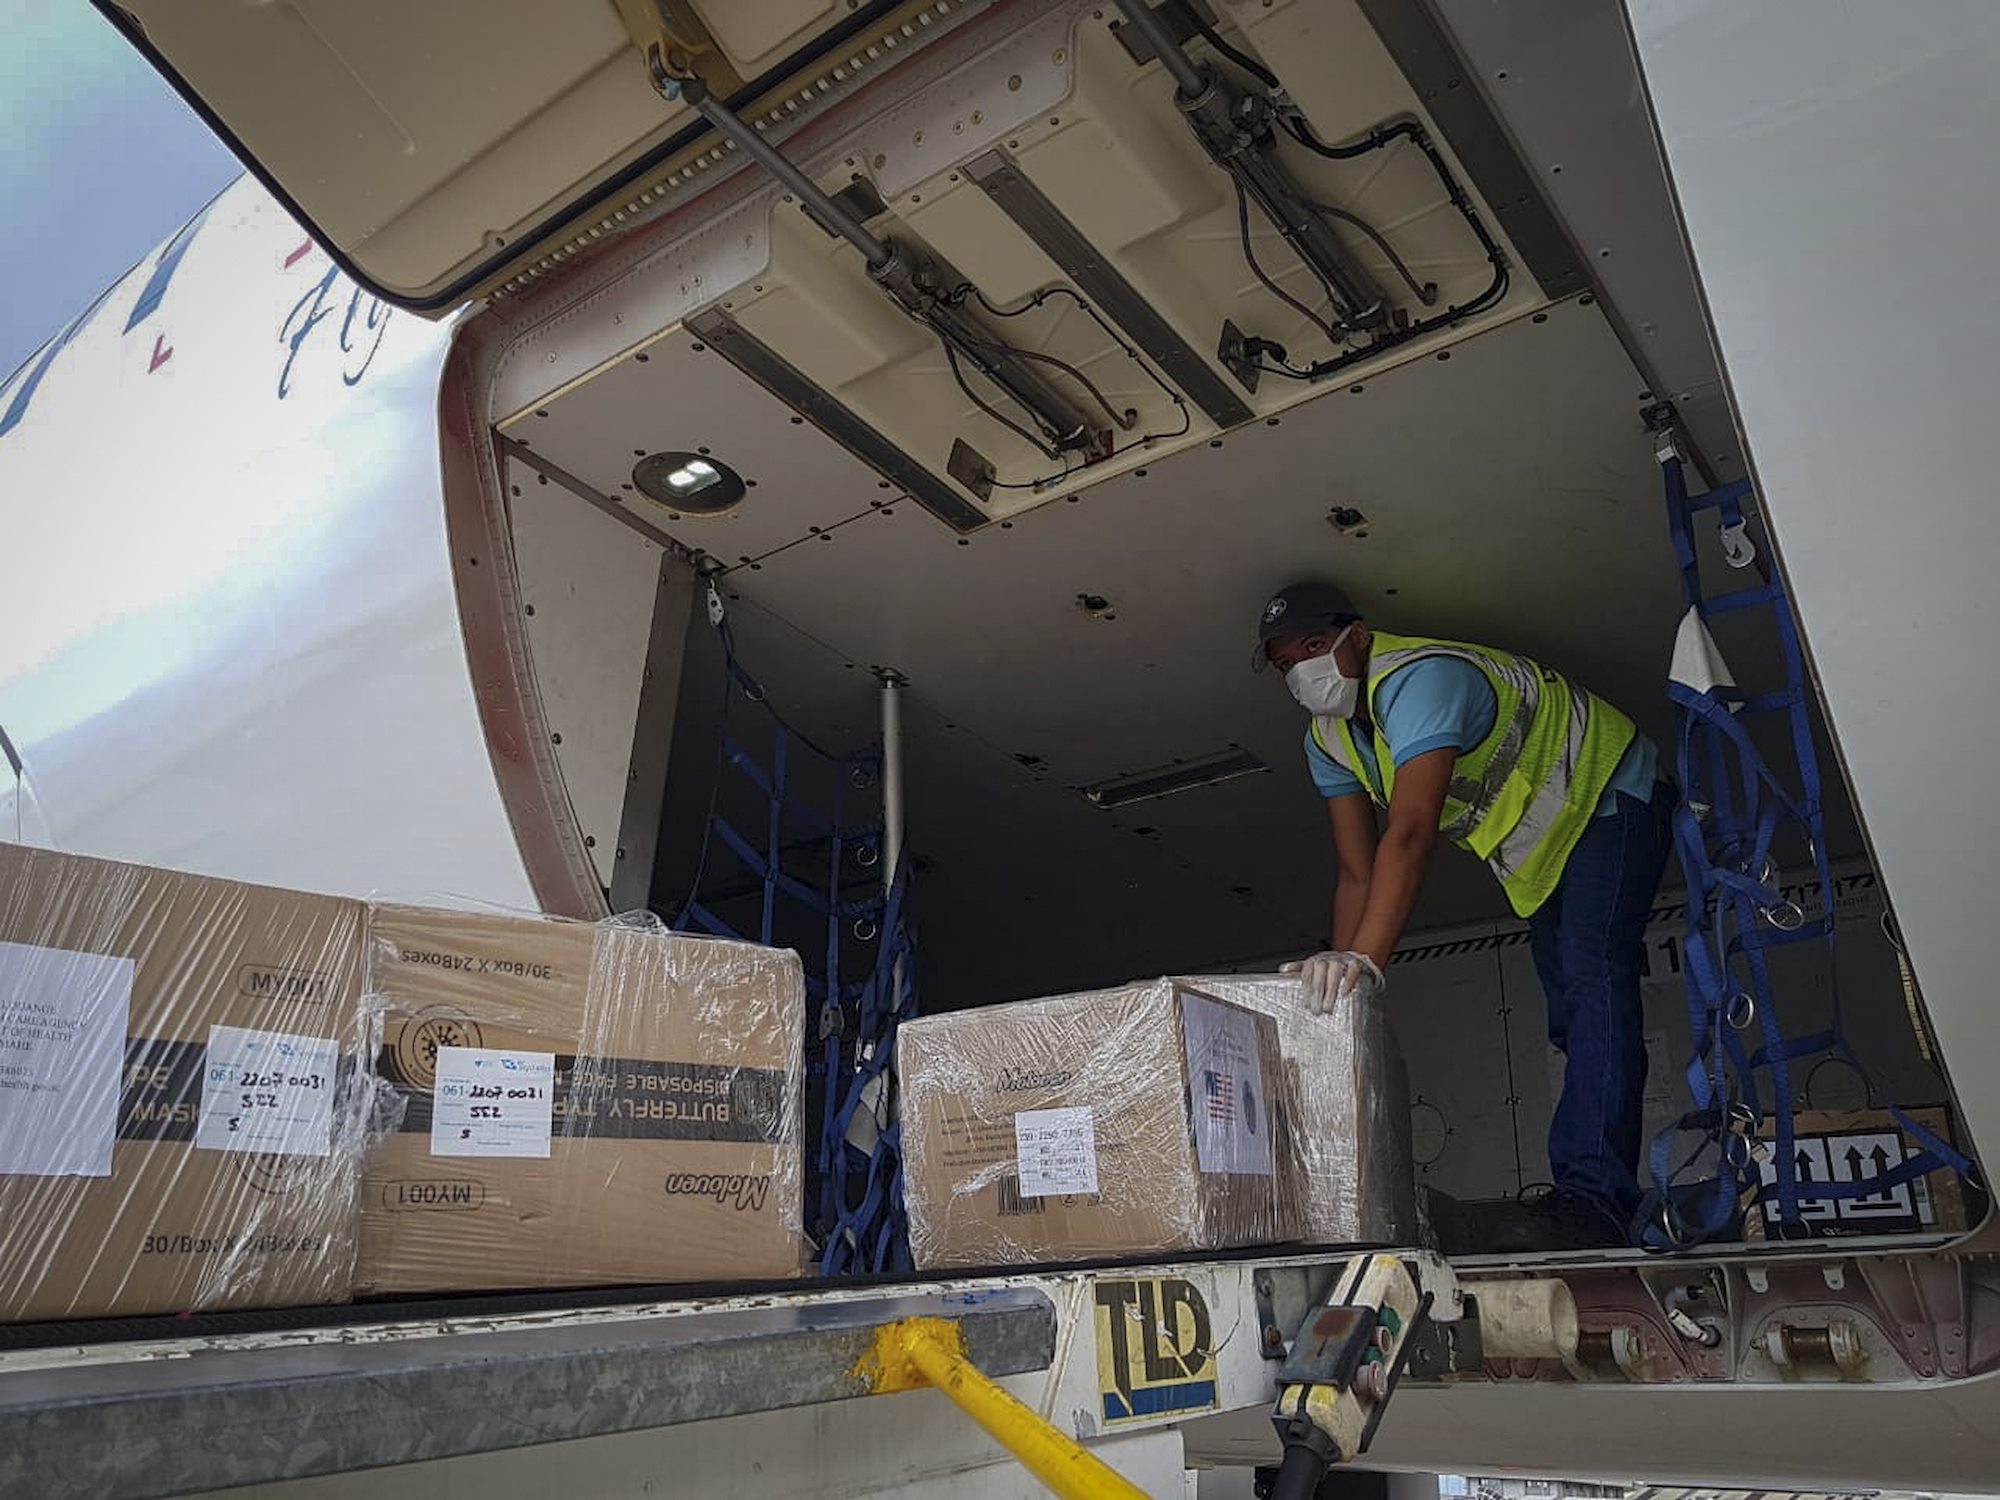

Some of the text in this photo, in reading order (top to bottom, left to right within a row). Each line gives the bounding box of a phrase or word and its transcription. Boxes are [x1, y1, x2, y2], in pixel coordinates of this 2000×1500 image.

[401, 950, 475, 972] 24Boxes
[628, 1073, 731, 1096] DISPOSABLE
[553, 1095, 730, 1122] BUTTERFLY TYP
[399, 1184, 472, 1205] MY001
[1095, 1279, 1212, 1416] TLD
